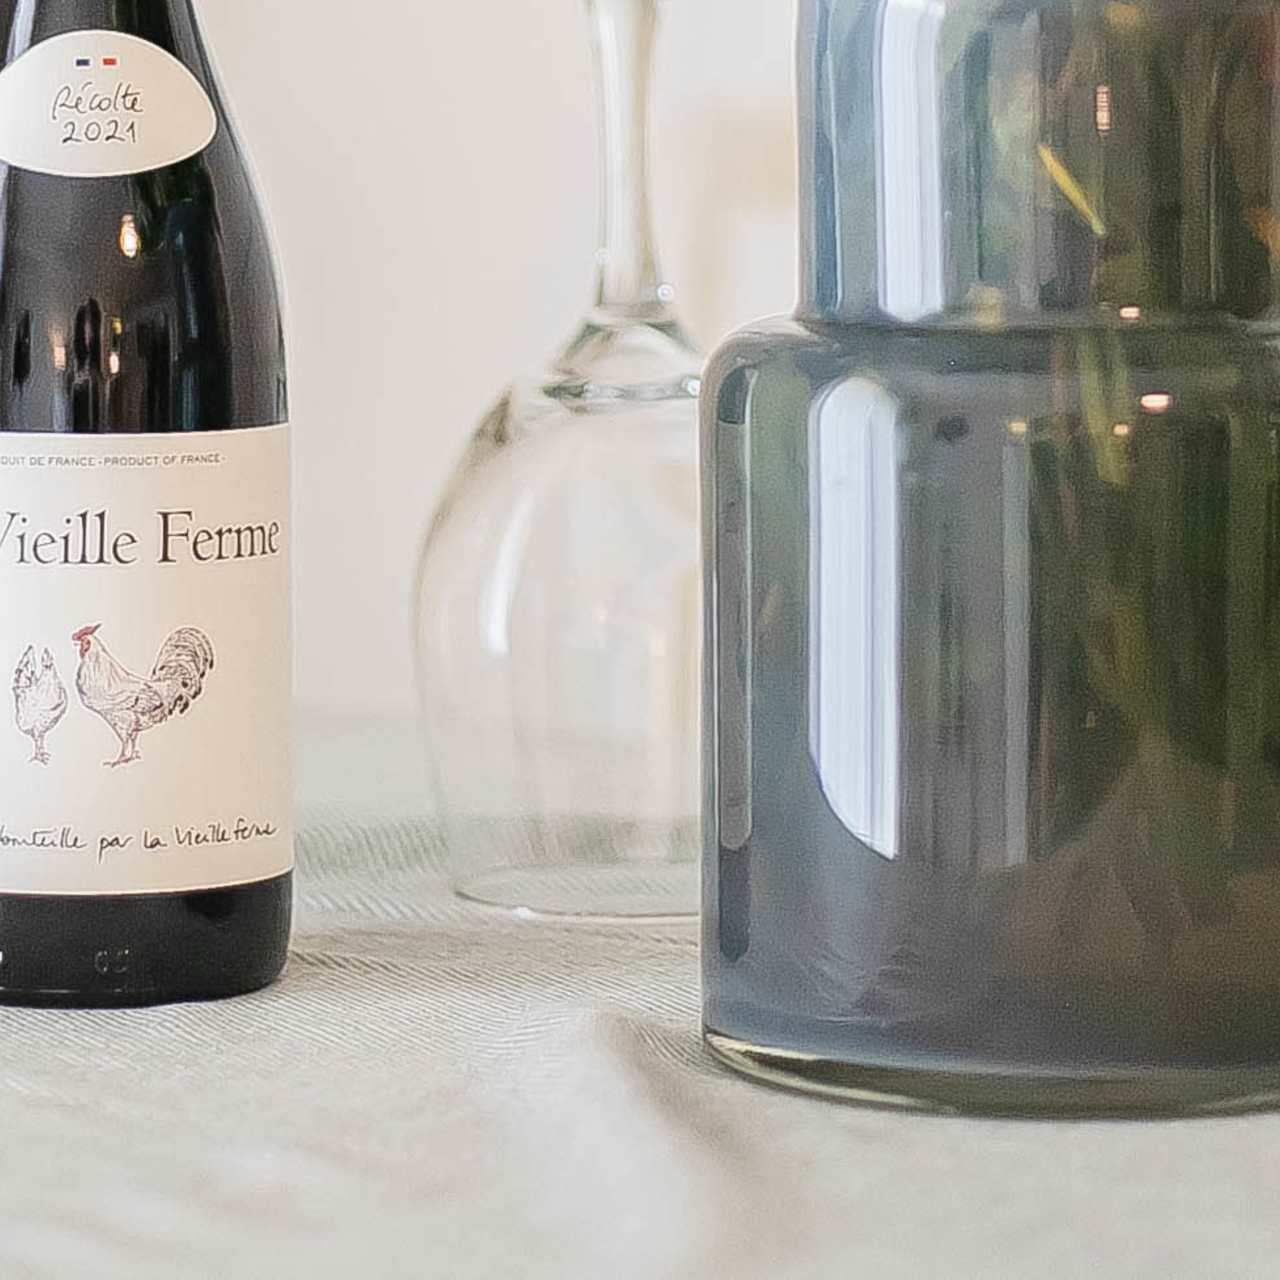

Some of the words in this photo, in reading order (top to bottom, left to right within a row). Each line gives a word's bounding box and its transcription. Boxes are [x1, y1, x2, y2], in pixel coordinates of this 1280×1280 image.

[51, 81, 144, 121] Récolte
[62, 120, 137, 144] 2021
[156, 510, 281, 563] Ferme
[97, 835, 133, 864] par
